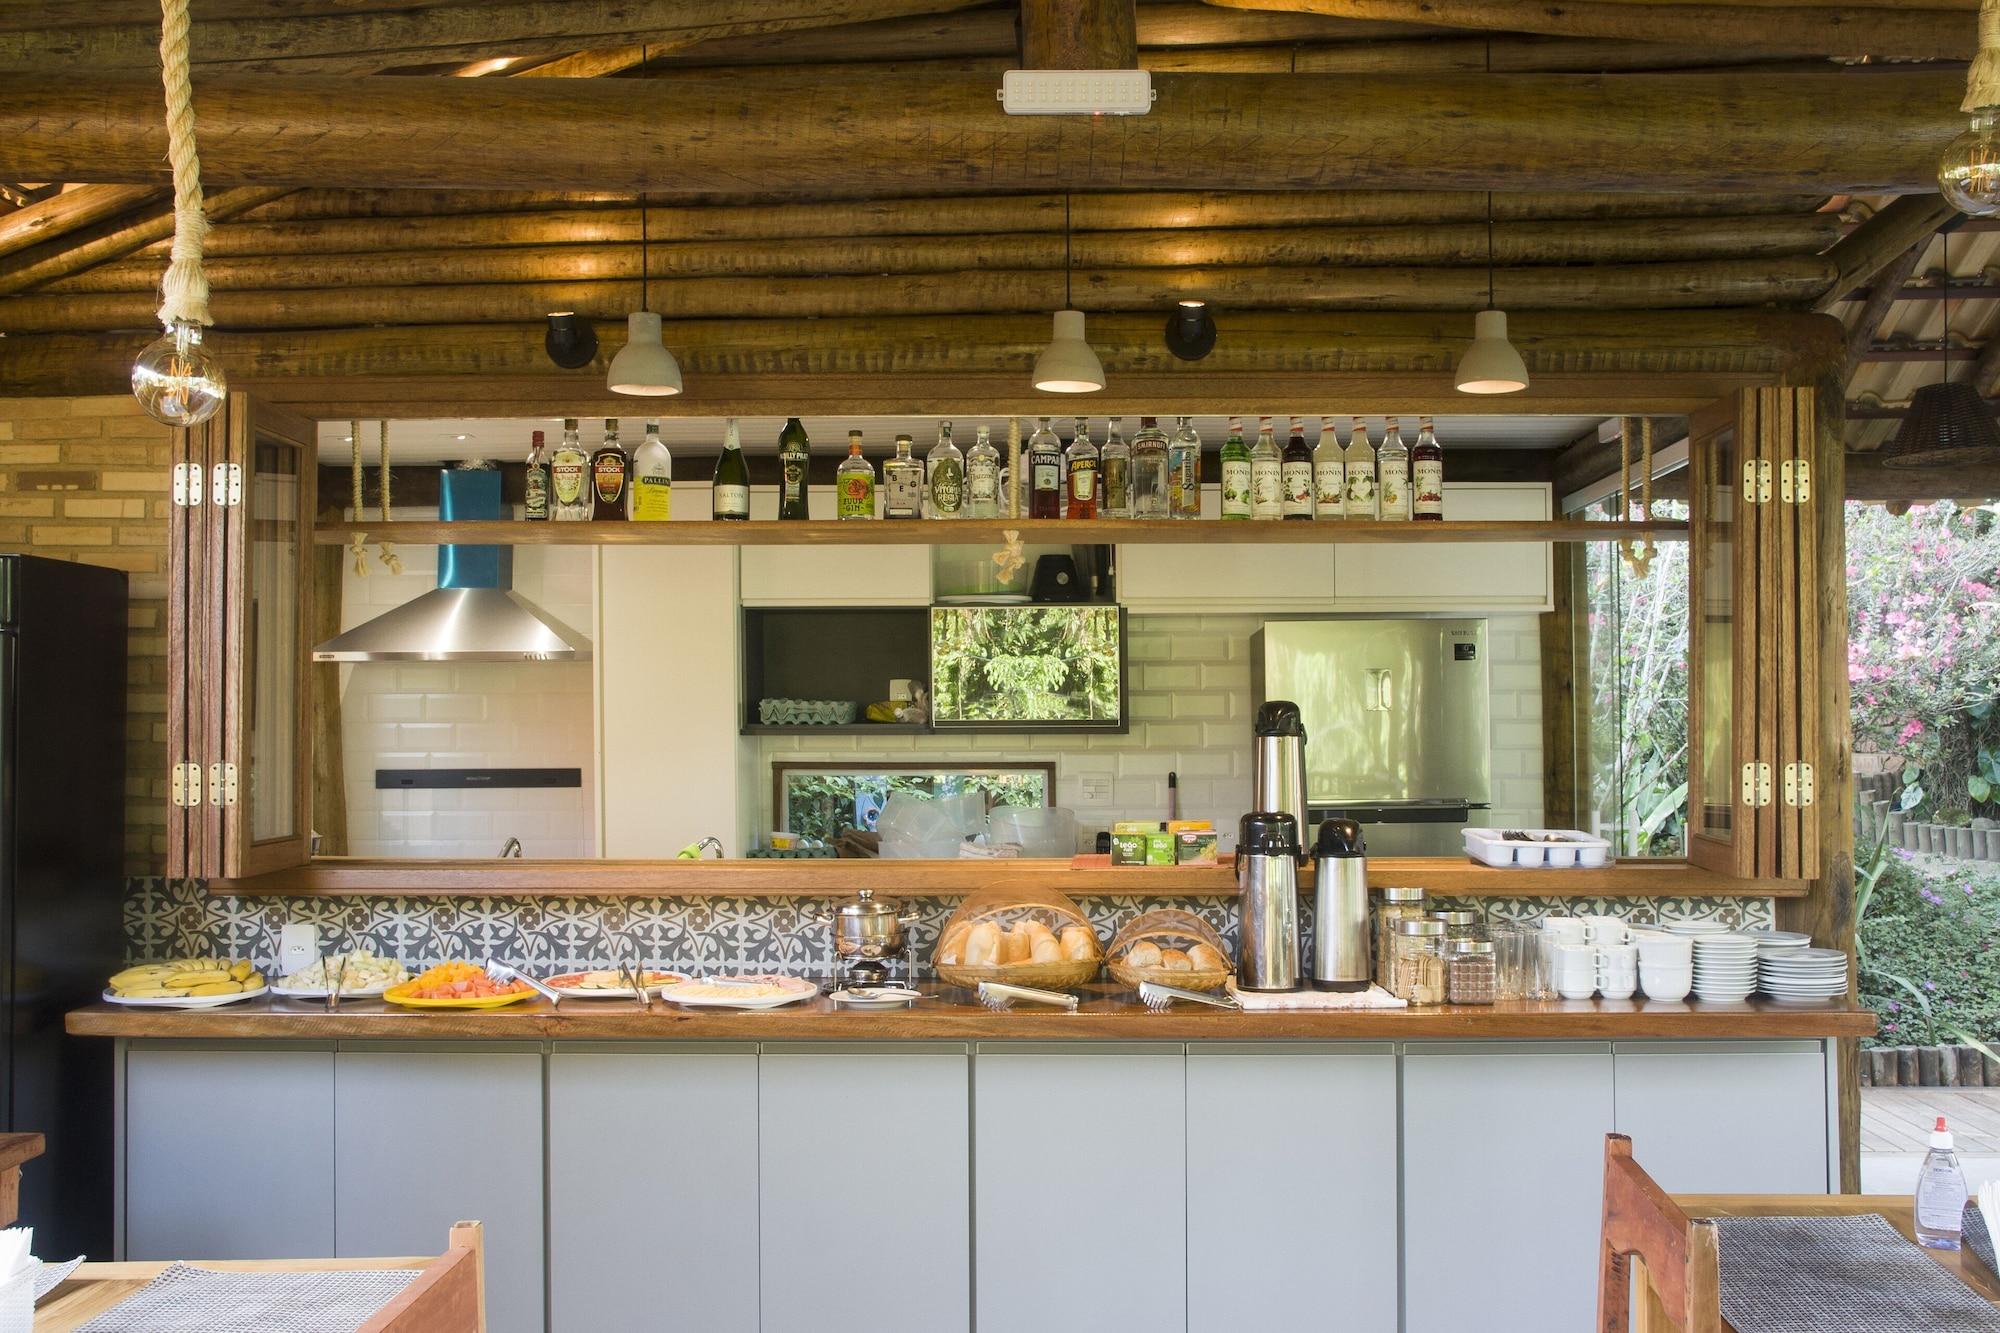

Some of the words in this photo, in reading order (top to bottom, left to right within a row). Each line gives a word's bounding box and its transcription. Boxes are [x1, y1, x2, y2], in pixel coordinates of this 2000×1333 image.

[1137, 440, 1166, 450] SMIRNOFF
[1182, 451, 1194, 490] Sagatiba
[644, 477, 670, 486] PALLIN
